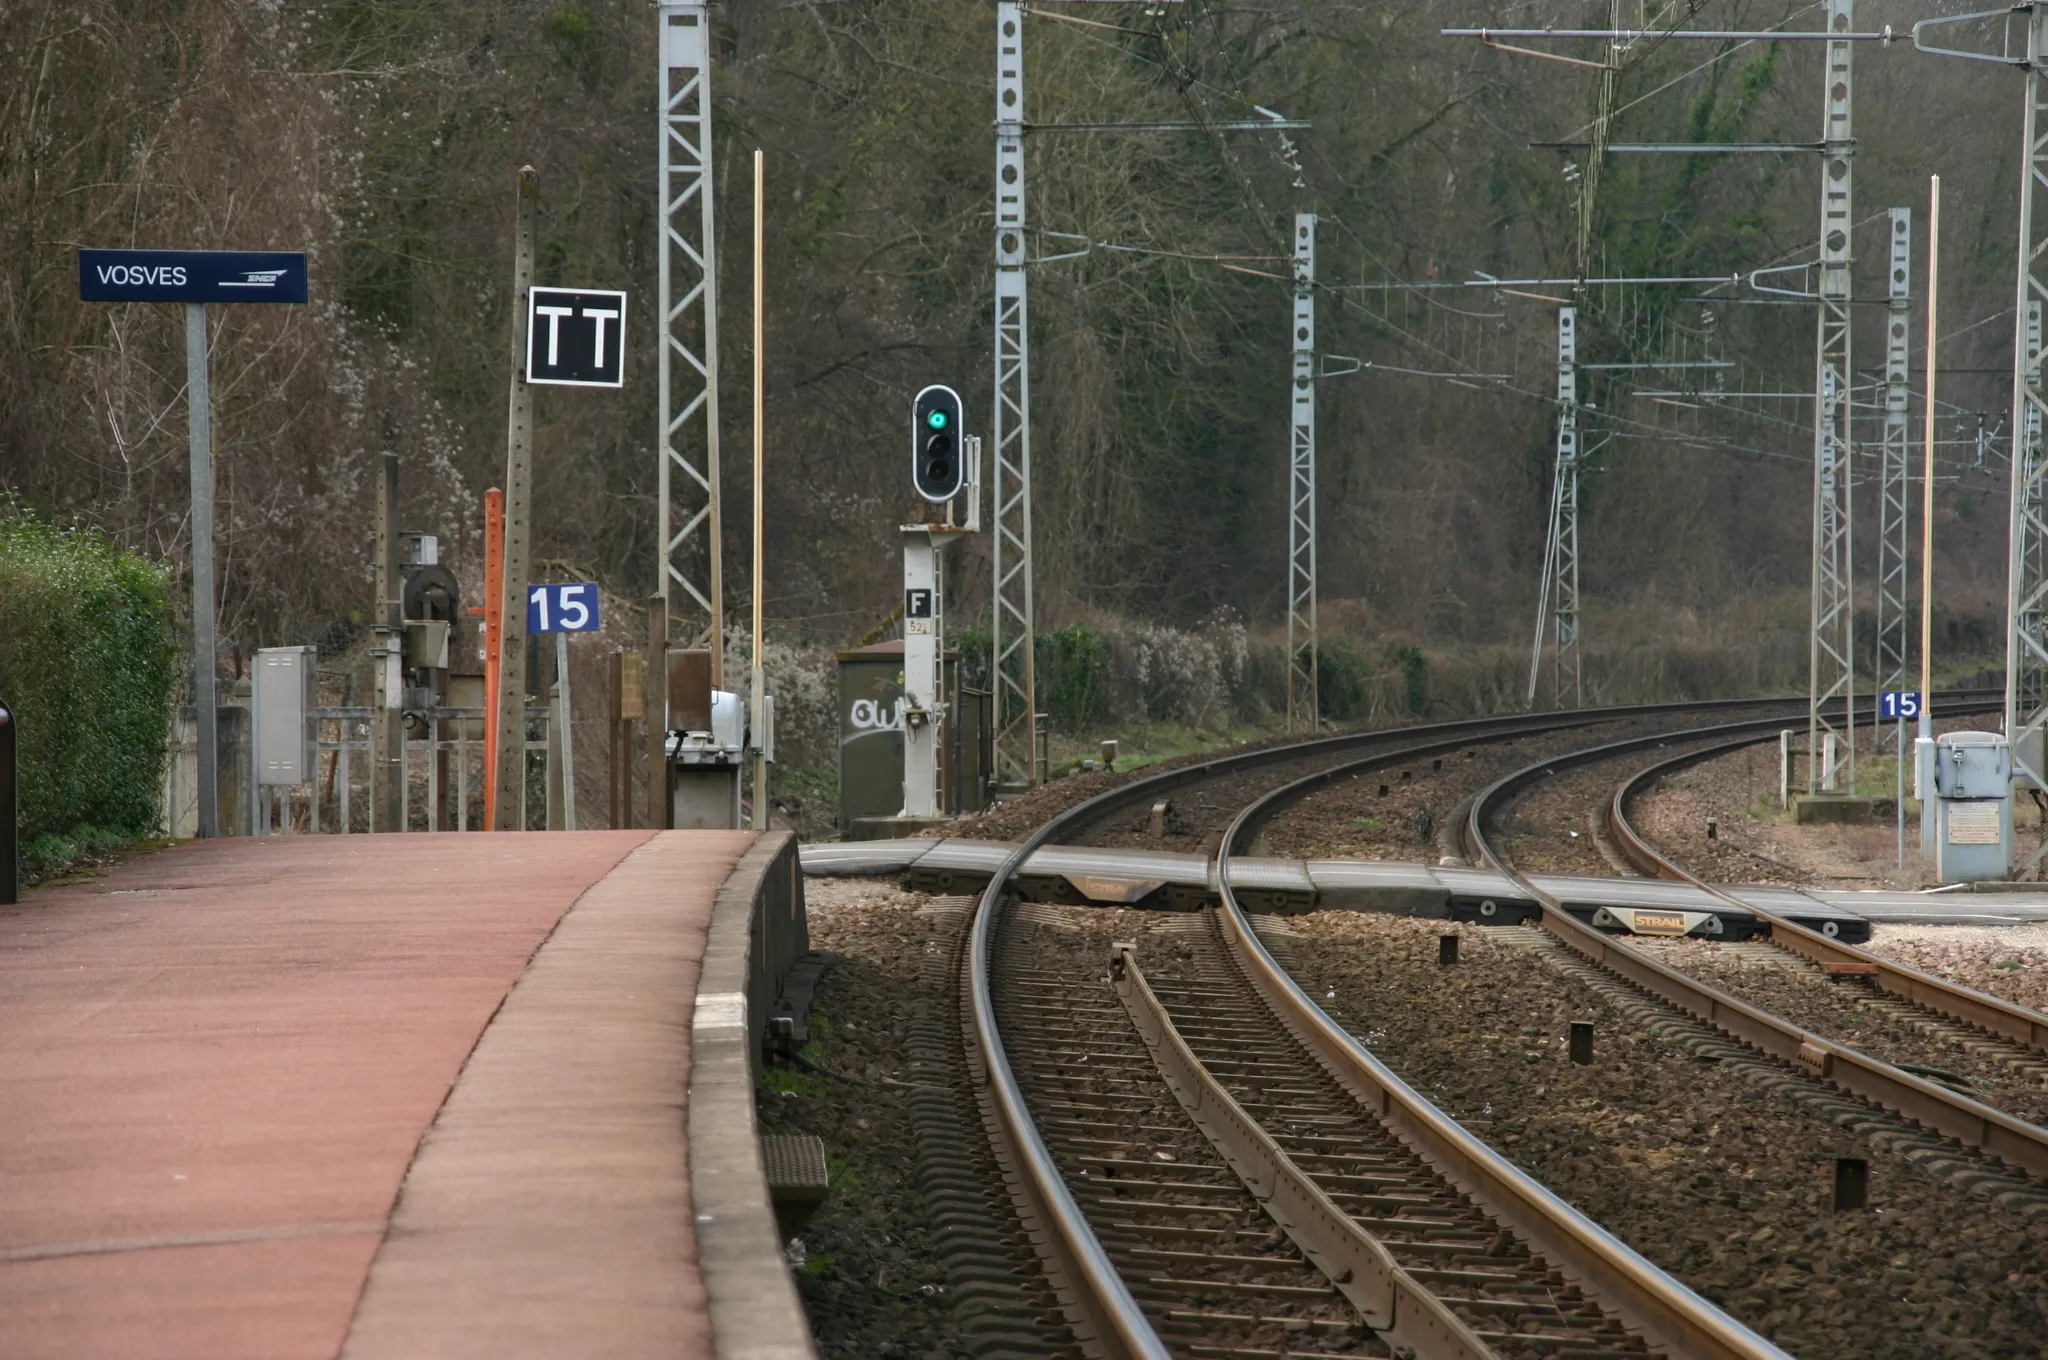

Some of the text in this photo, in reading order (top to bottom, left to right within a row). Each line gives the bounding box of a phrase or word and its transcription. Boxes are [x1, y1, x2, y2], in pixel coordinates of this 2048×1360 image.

[97, 266, 187, 285] VOSVES
[247, 274, 277, 282] SNCF
[530, 586, 589, 630] 15
[911, 592, 926, 614] F
[1885, 692, 1917, 716] 15
[1635, 916, 1684, 927] STRAIL
